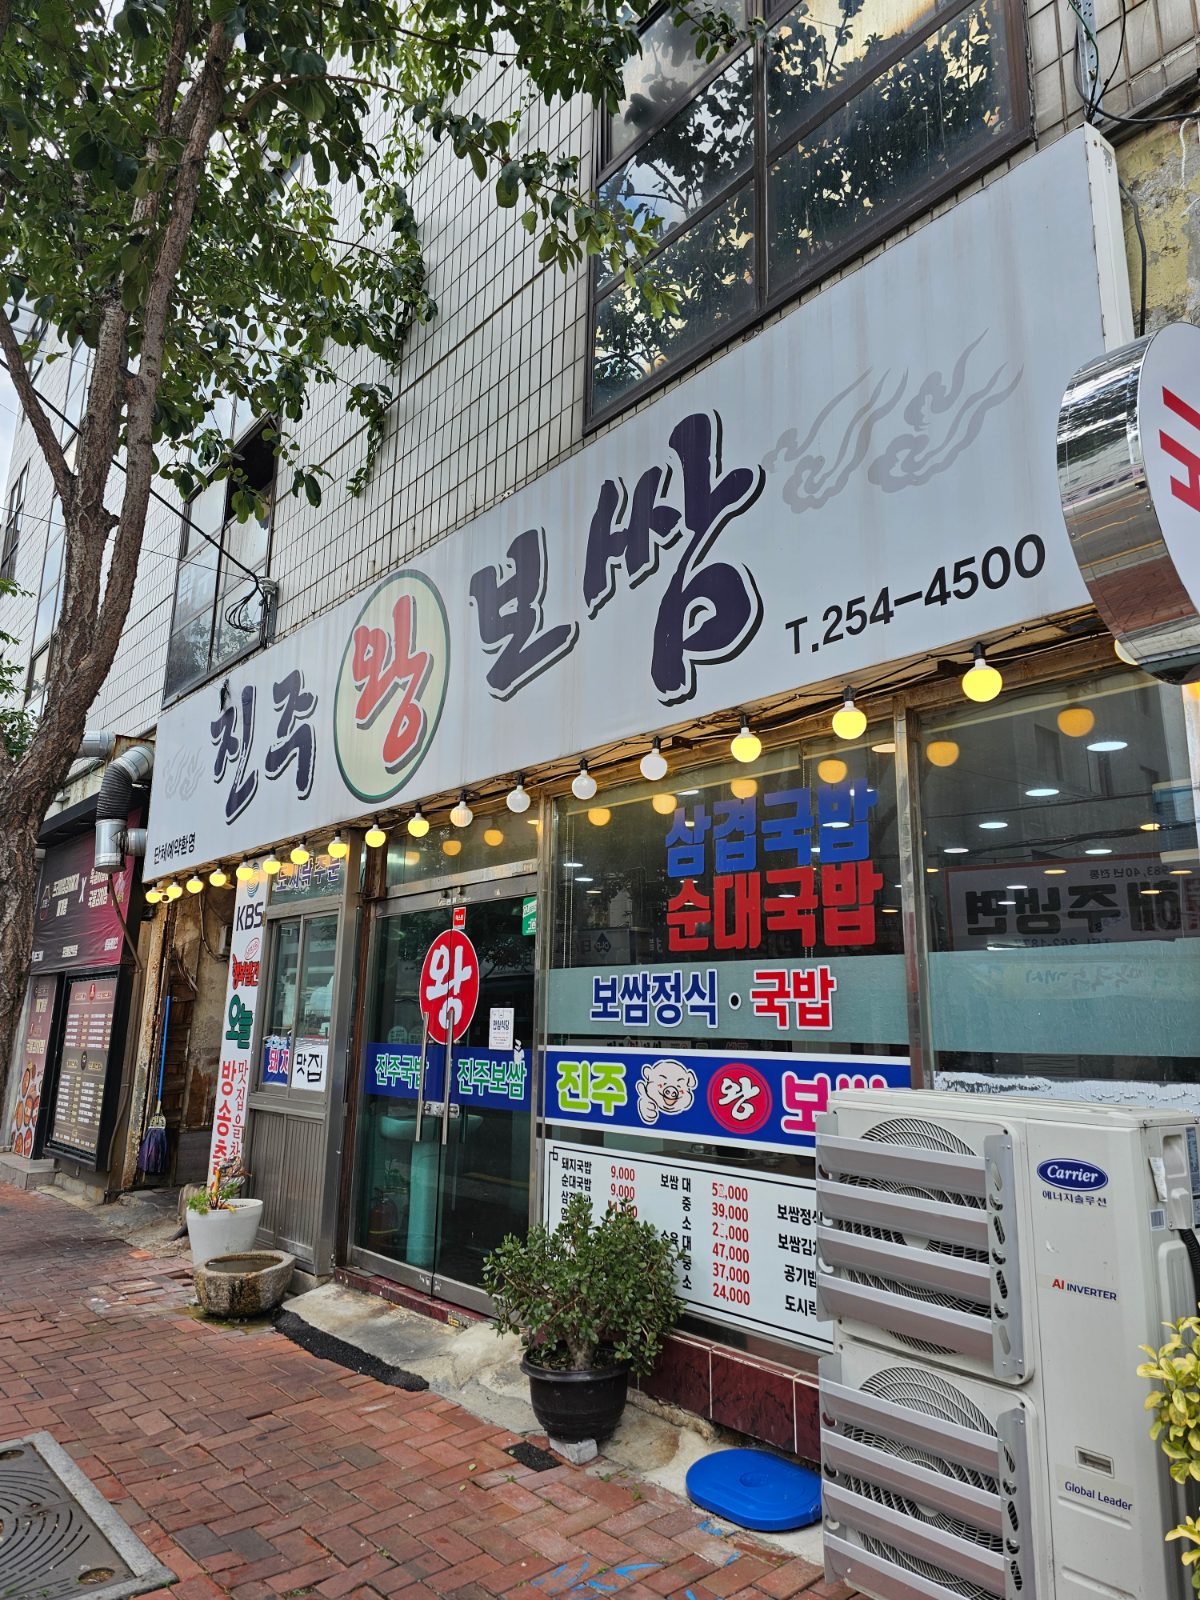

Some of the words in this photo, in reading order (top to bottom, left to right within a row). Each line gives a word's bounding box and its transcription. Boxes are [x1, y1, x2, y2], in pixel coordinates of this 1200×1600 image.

[210, 669, 317, 824] 진주
[352, 595, 434, 773] 왕
[469, 410, 766, 706] 보쌈
[665, 778, 878, 877] 삼겹국밥
[235, 901, 264, 932] KBS
[666, 861, 884, 952] 순대국밥
[426, 944, 472, 1029] 왕
[590, 969, 719, 1029] 보쌈정식
[750, 965, 838, 1031] 국밥
[225, 994, 253, 1050] 오늘
[296, 1053, 323, 1083] 맛집
[457, 1058, 527, 1100] 진주보쌈
[557, 1060, 627, 1117] 진주
[718, 1076, 760, 1121] 왕
[561, 1157, 592, 1175] 돼지국밥
[610, 1165, 636, 1182] 9,000
[660, 1174, 679, 1191] 보쌈
[682, 1177, 691, 1193] 대
[1047, 1165, 1099, 1183] Carrier
[561, 1174, 592, 1192] 순대국밥
[610, 1183, 635, 1200] 9,000
[1042, 1190, 1107, 1208] 에너지솔루션
[682, 1196, 691, 1212] 중
[712, 1202, 749, 1222] 39,000
[682, 1216, 691, 1231] 소
[712, 1222, 749, 1243] 2,000
[682, 1234, 692, 1251] 대
[712, 1242, 750, 1264] 47,000
[712, 1262, 750, 1285] 37,000
[682, 1275, 692, 1290] 소
[713, 1283, 750, 1306] 24,000
[1052, 1278, 1065, 1290] AI
[1067, 1283, 1117, 1301] INVERTER
[1064, 1481, 1096, 1501] Global
[1098, 1491, 1133, 1511] Leader
